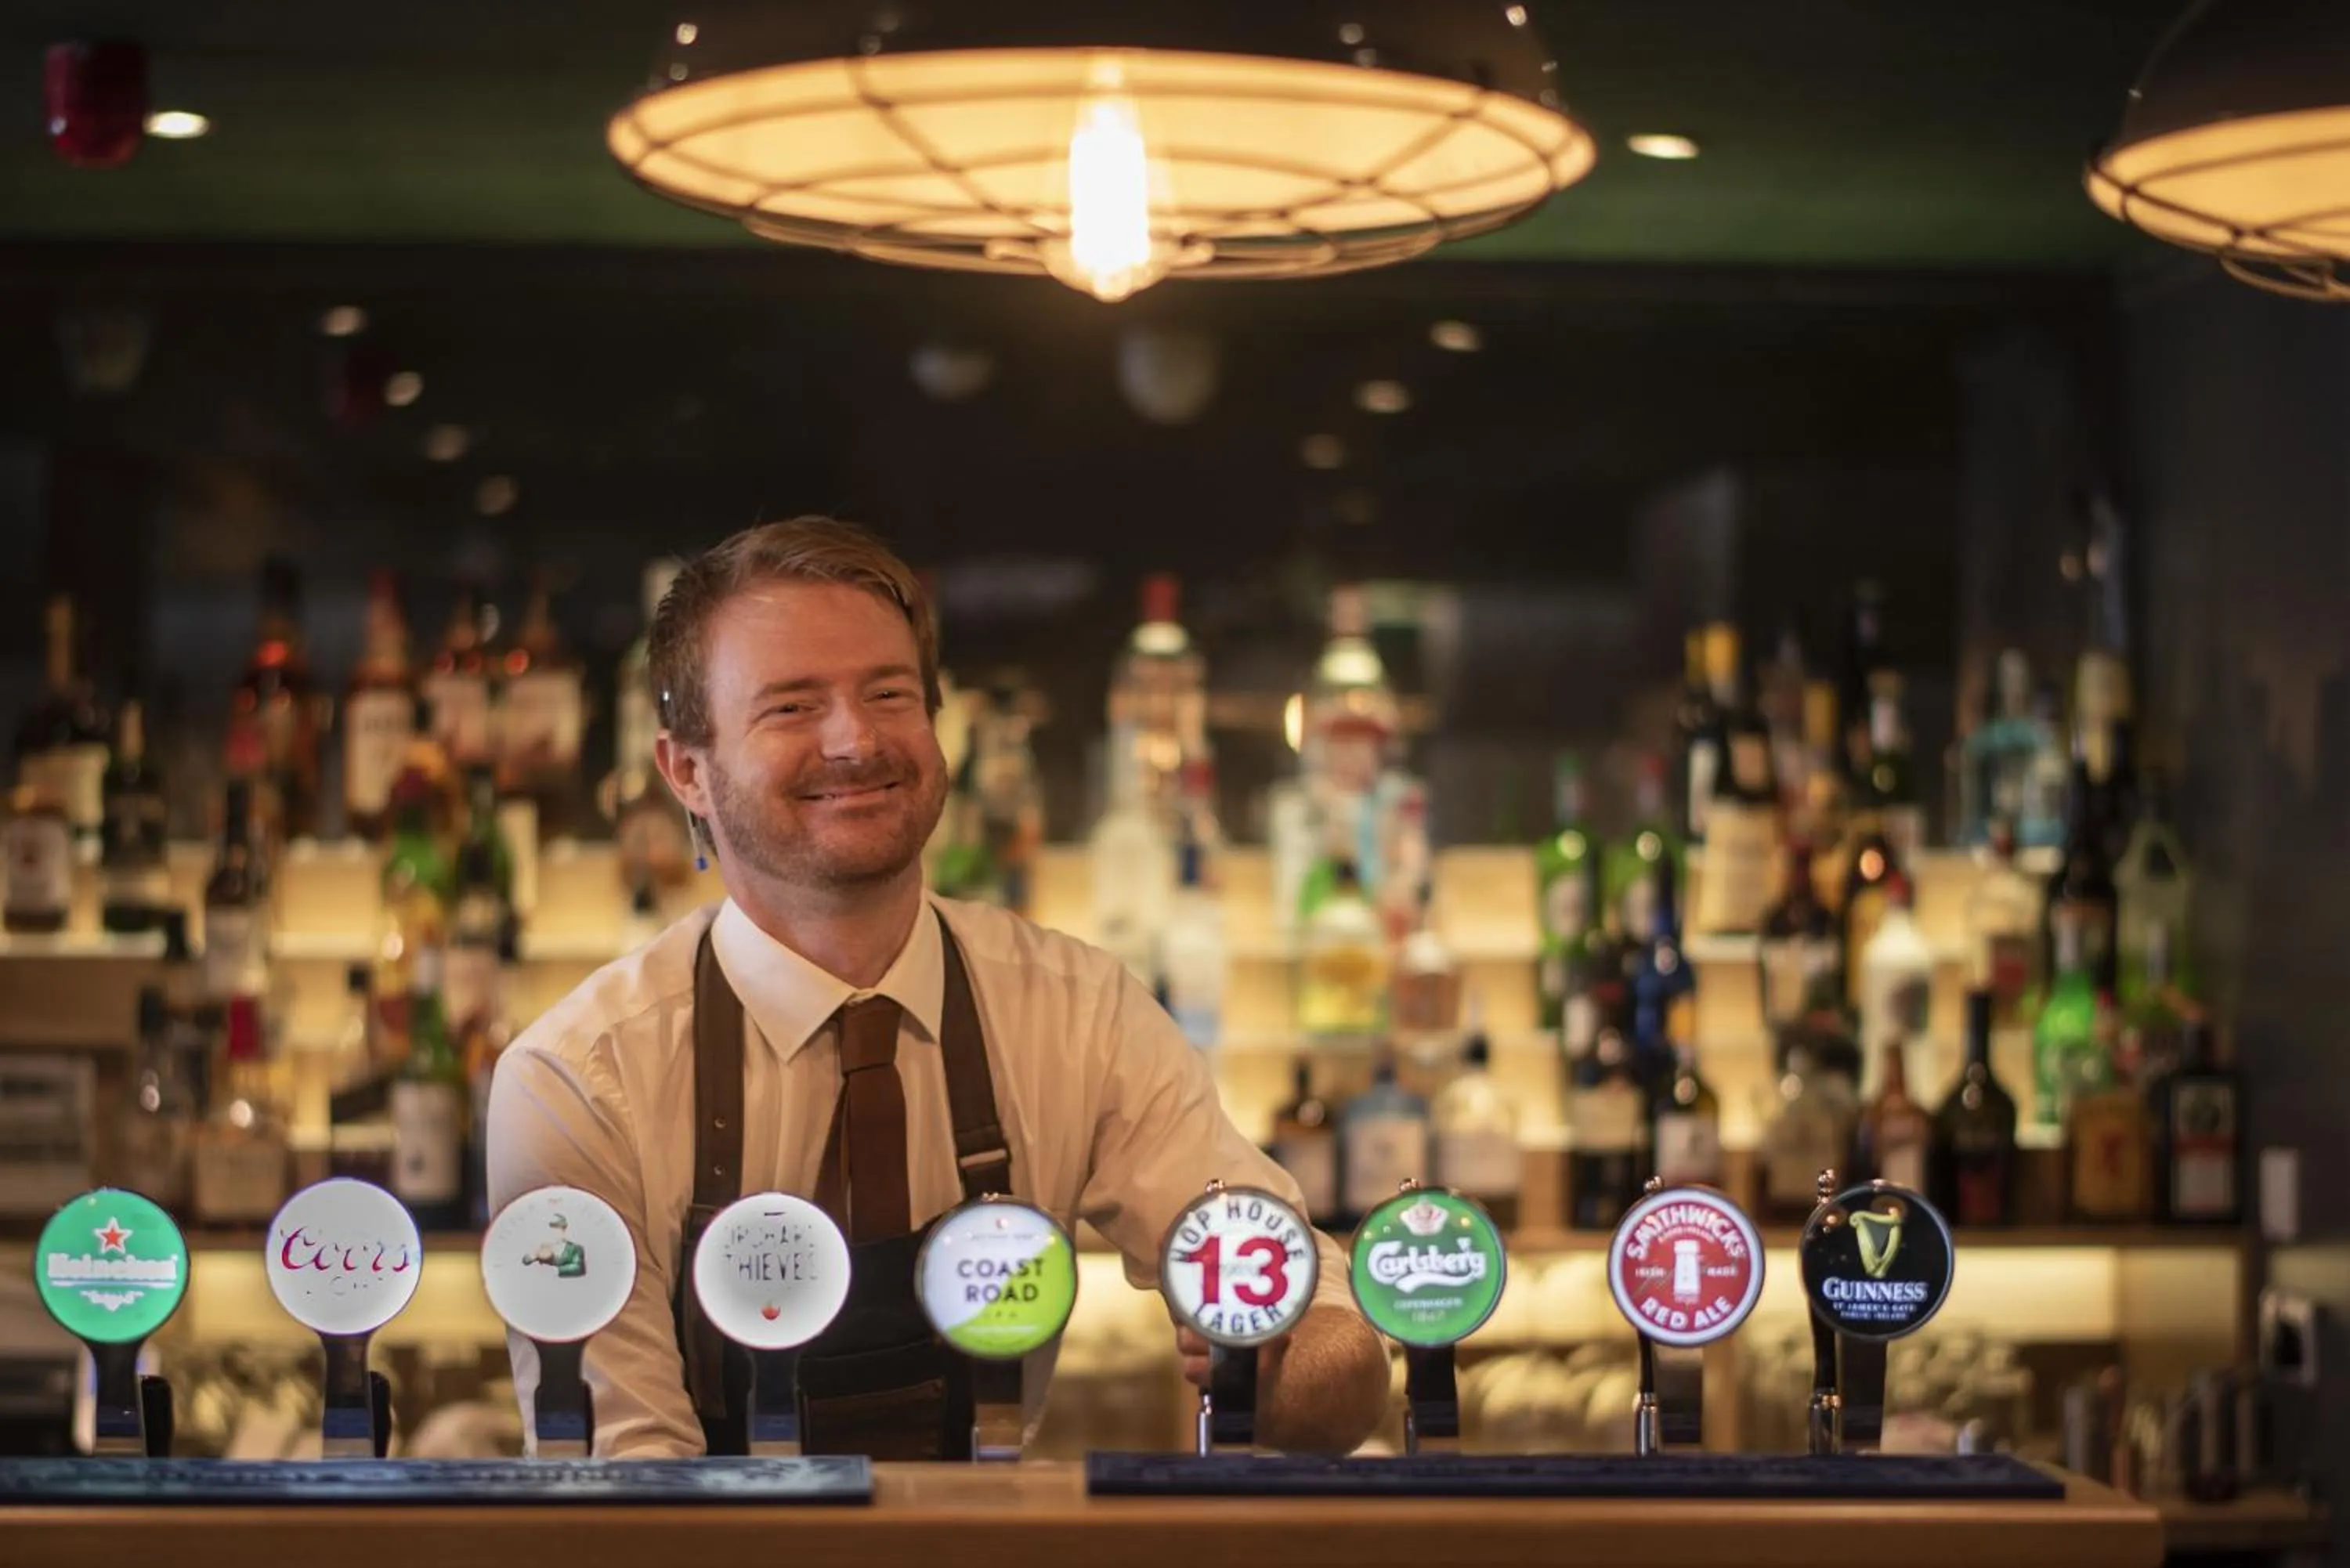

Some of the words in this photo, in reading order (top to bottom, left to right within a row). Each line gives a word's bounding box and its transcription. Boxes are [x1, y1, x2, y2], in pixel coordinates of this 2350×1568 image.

[956, 1257, 1043, 1278] COAST
[1188, 1235, 1289, 1306] 13
[1368, 1237, 1487, 1294] Carlsberg
[965, 1283, 1039, 1304] ROAD
[1822, 1276, 1929, 1302] GUINNESS
[1194, 1302, 1283, 1334] LAGER
[1641, 1296, 1688, 1329] RED
[1694, 1295, 1734, 1328] ALE
